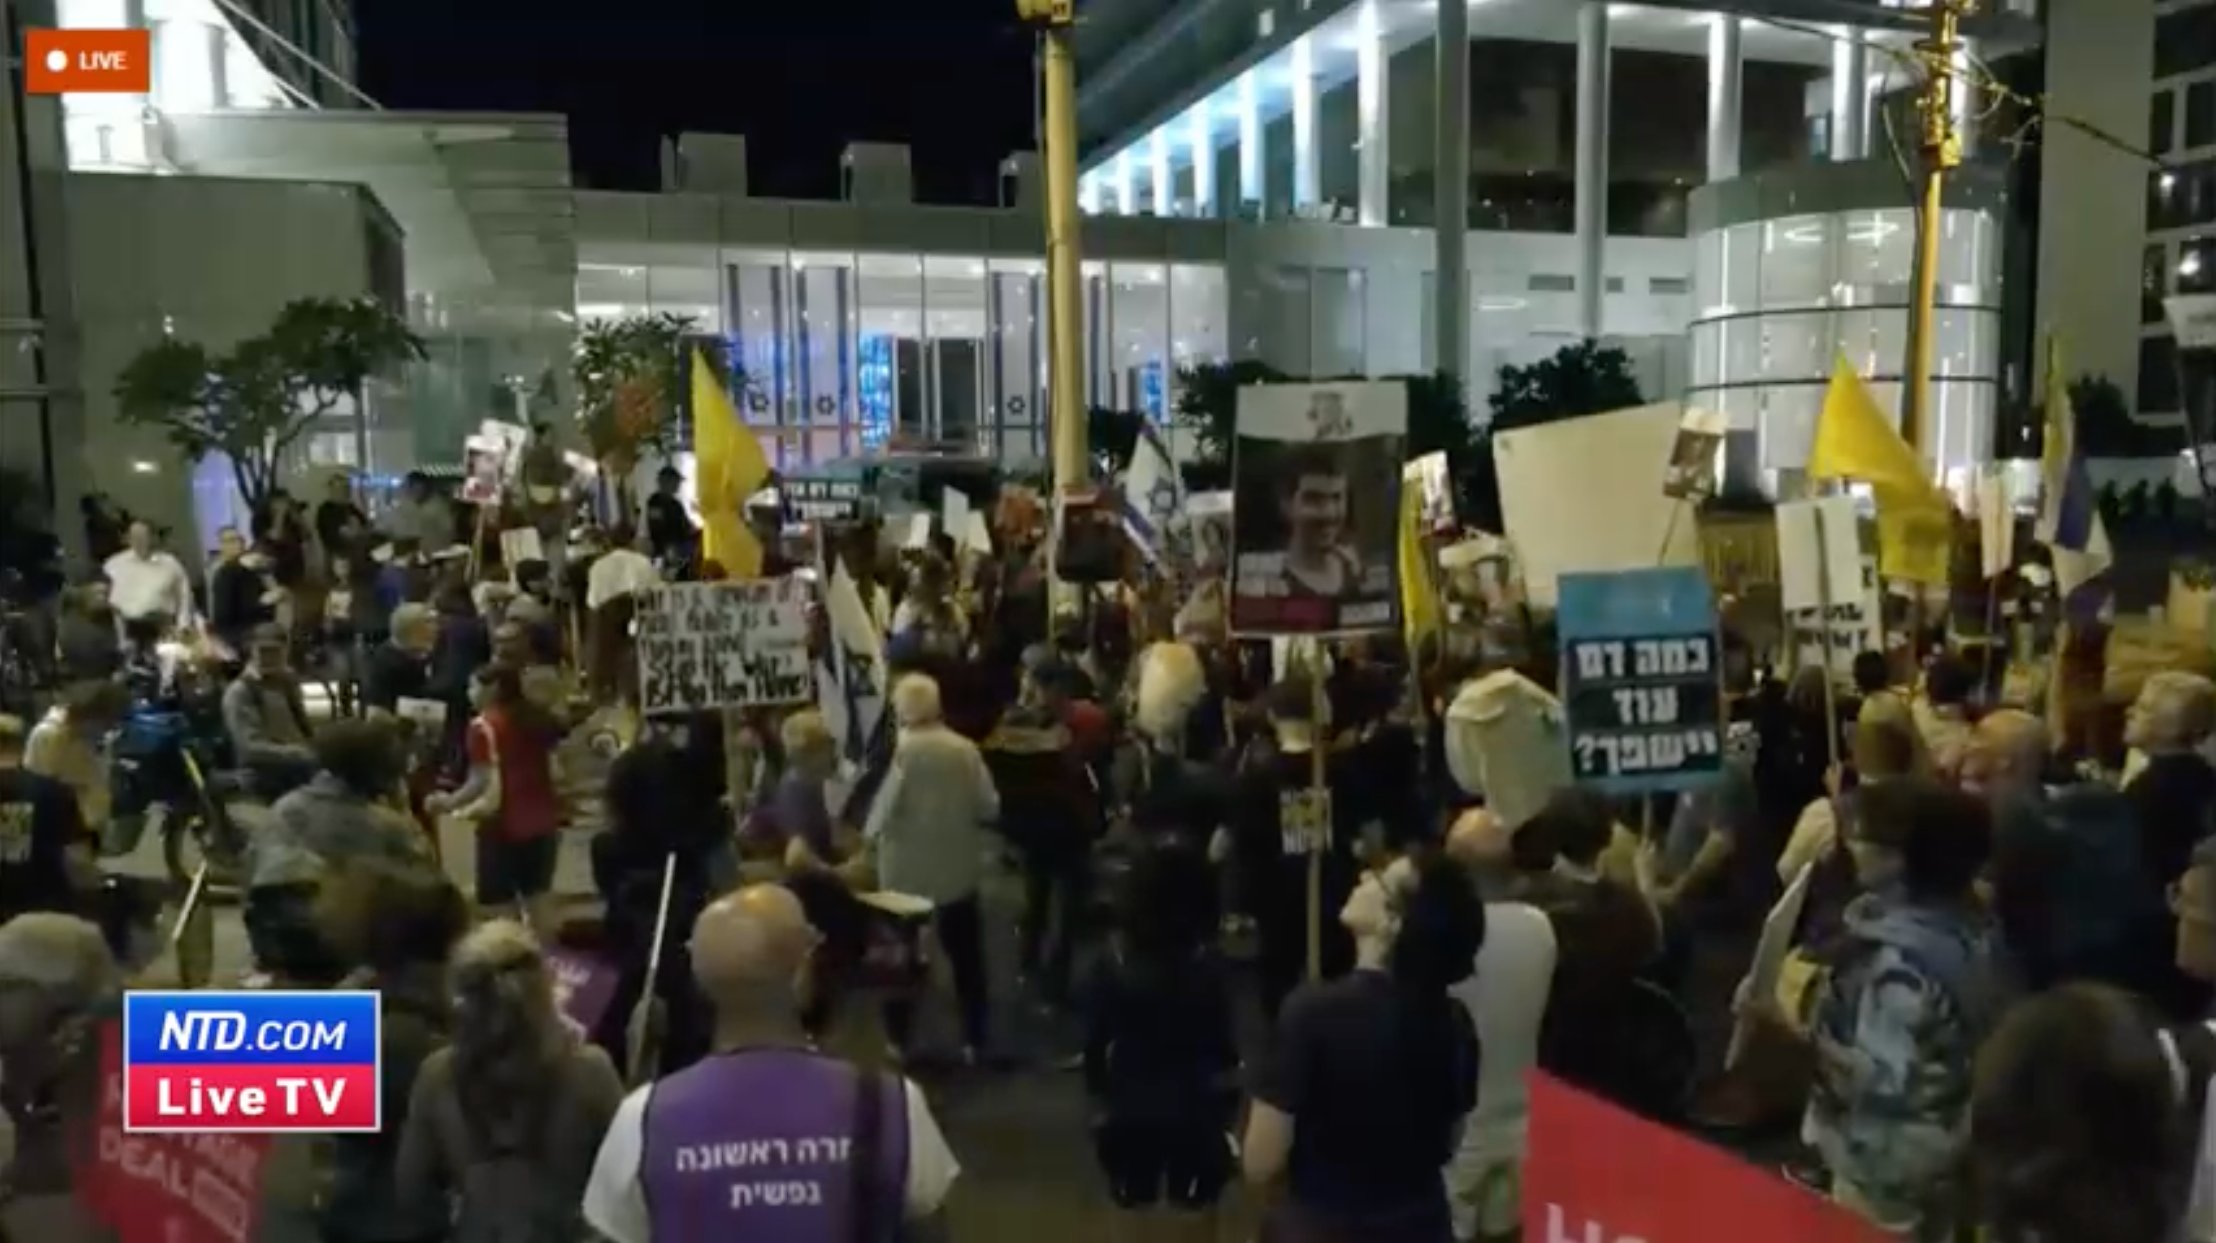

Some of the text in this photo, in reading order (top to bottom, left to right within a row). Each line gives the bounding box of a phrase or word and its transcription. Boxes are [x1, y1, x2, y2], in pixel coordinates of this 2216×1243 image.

[1575, 637, 1710, 679] כמה דם
[1612, 686, 1679, 724] עוד
[98, 1125, 189, 1199] DEAL
[676, 1134, 853, 1173] זרה ראשונה
[729, 1179, 823, 1210] נפשית
